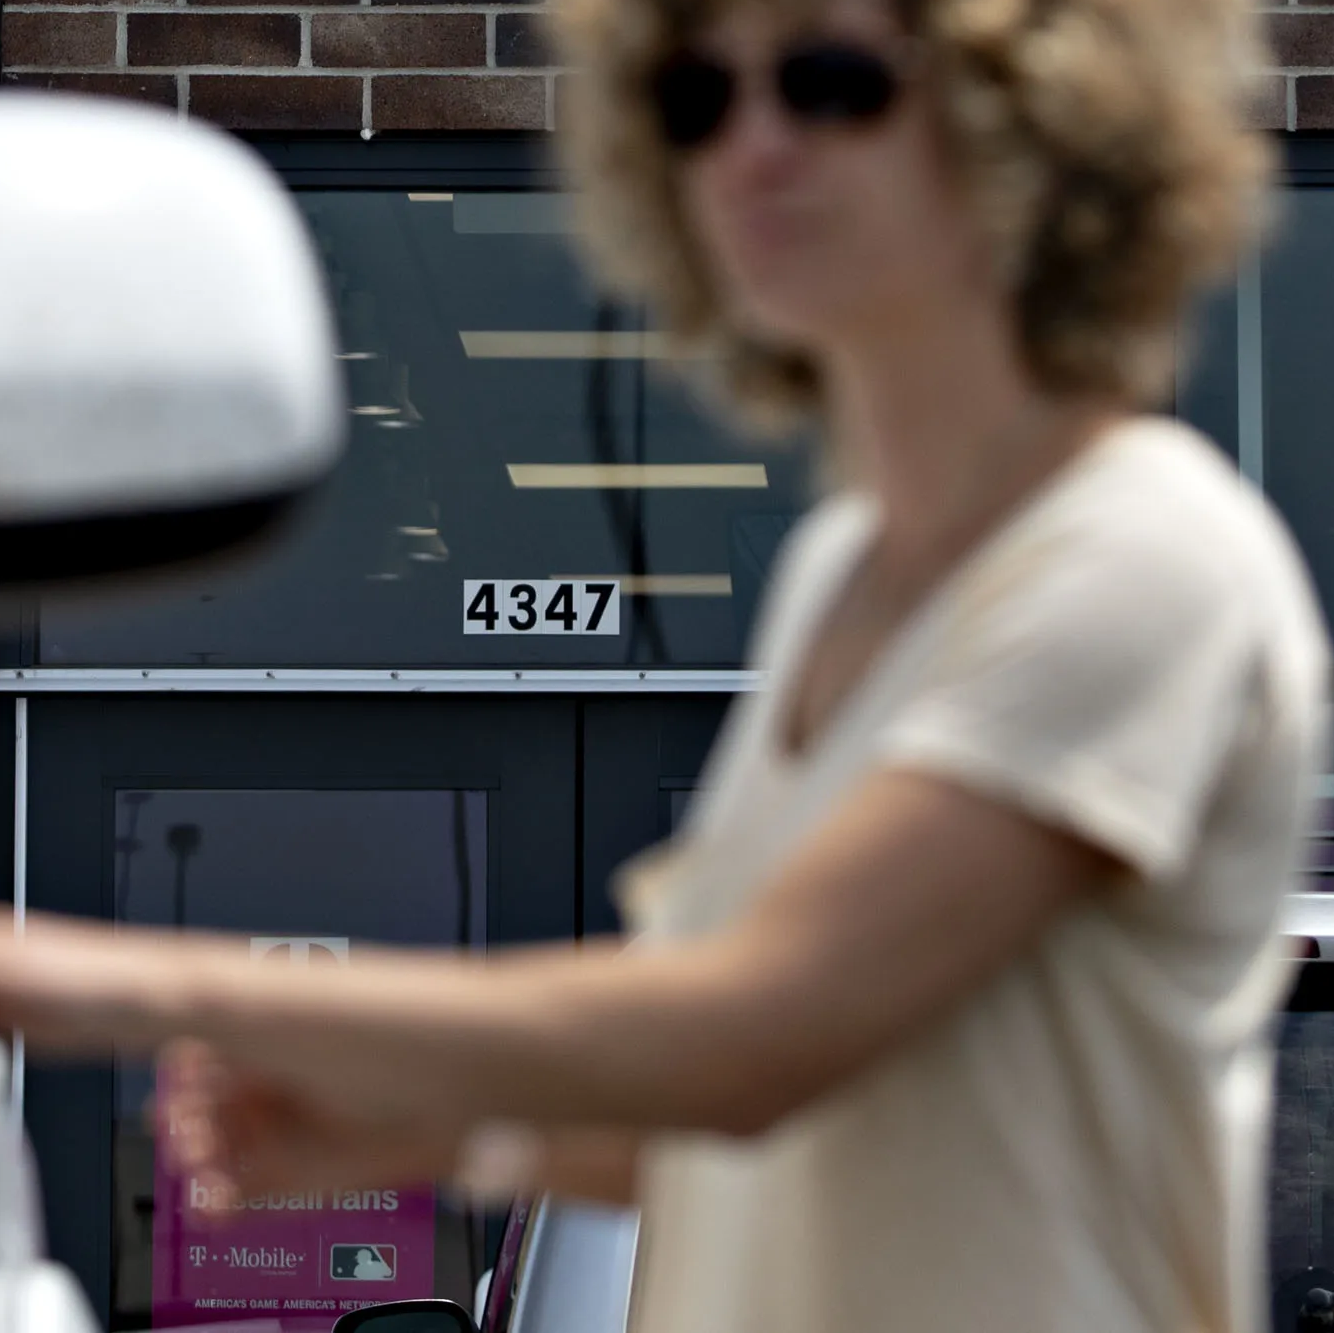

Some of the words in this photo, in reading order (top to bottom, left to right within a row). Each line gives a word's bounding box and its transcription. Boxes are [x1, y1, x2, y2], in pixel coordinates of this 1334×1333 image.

[467, 583, 615, 631] 4347
[332, 1183, 399, 1210] fans
[195, 1298, 247, 1309] AMERICA'S
[283, 1300, 336, 1310] AMERICA'S
[339, 1300, 384, 1310] NETWO
